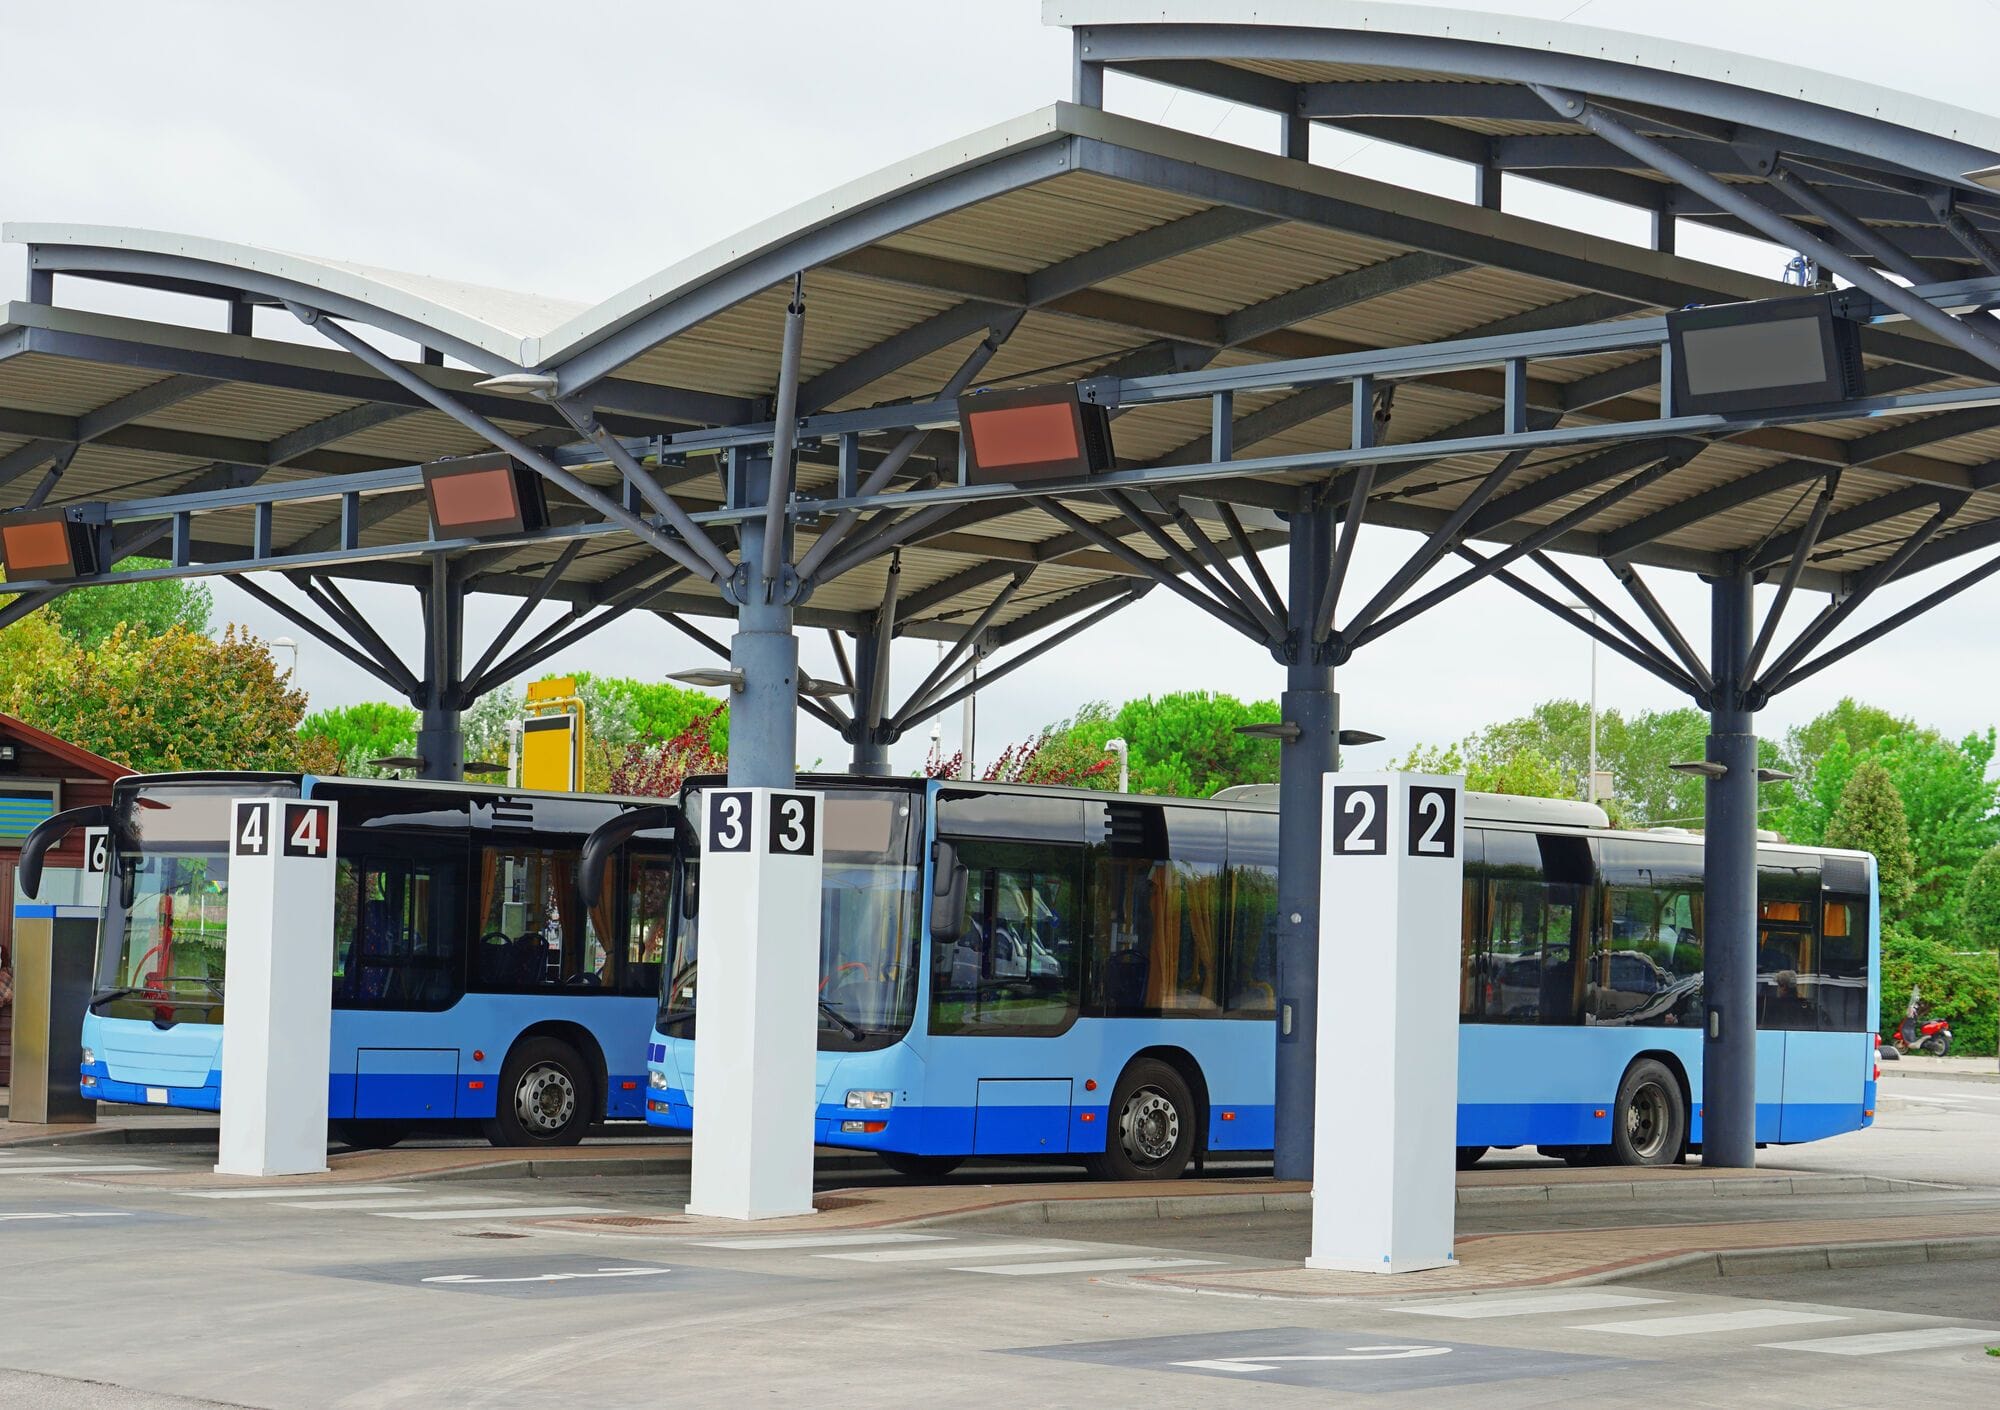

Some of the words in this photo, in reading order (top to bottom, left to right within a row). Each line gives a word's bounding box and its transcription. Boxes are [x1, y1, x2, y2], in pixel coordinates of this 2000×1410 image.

[241, 806, 263, 853] 4
[291, 808, 321, 855] 4
[718, 796, 744, 849] 3
[779, 799, 806, 852] 3
[1344, 790, 1376, 851] 2
[1418, 792, 1445, 853] 2
[93, 836, 107, 871] 6
